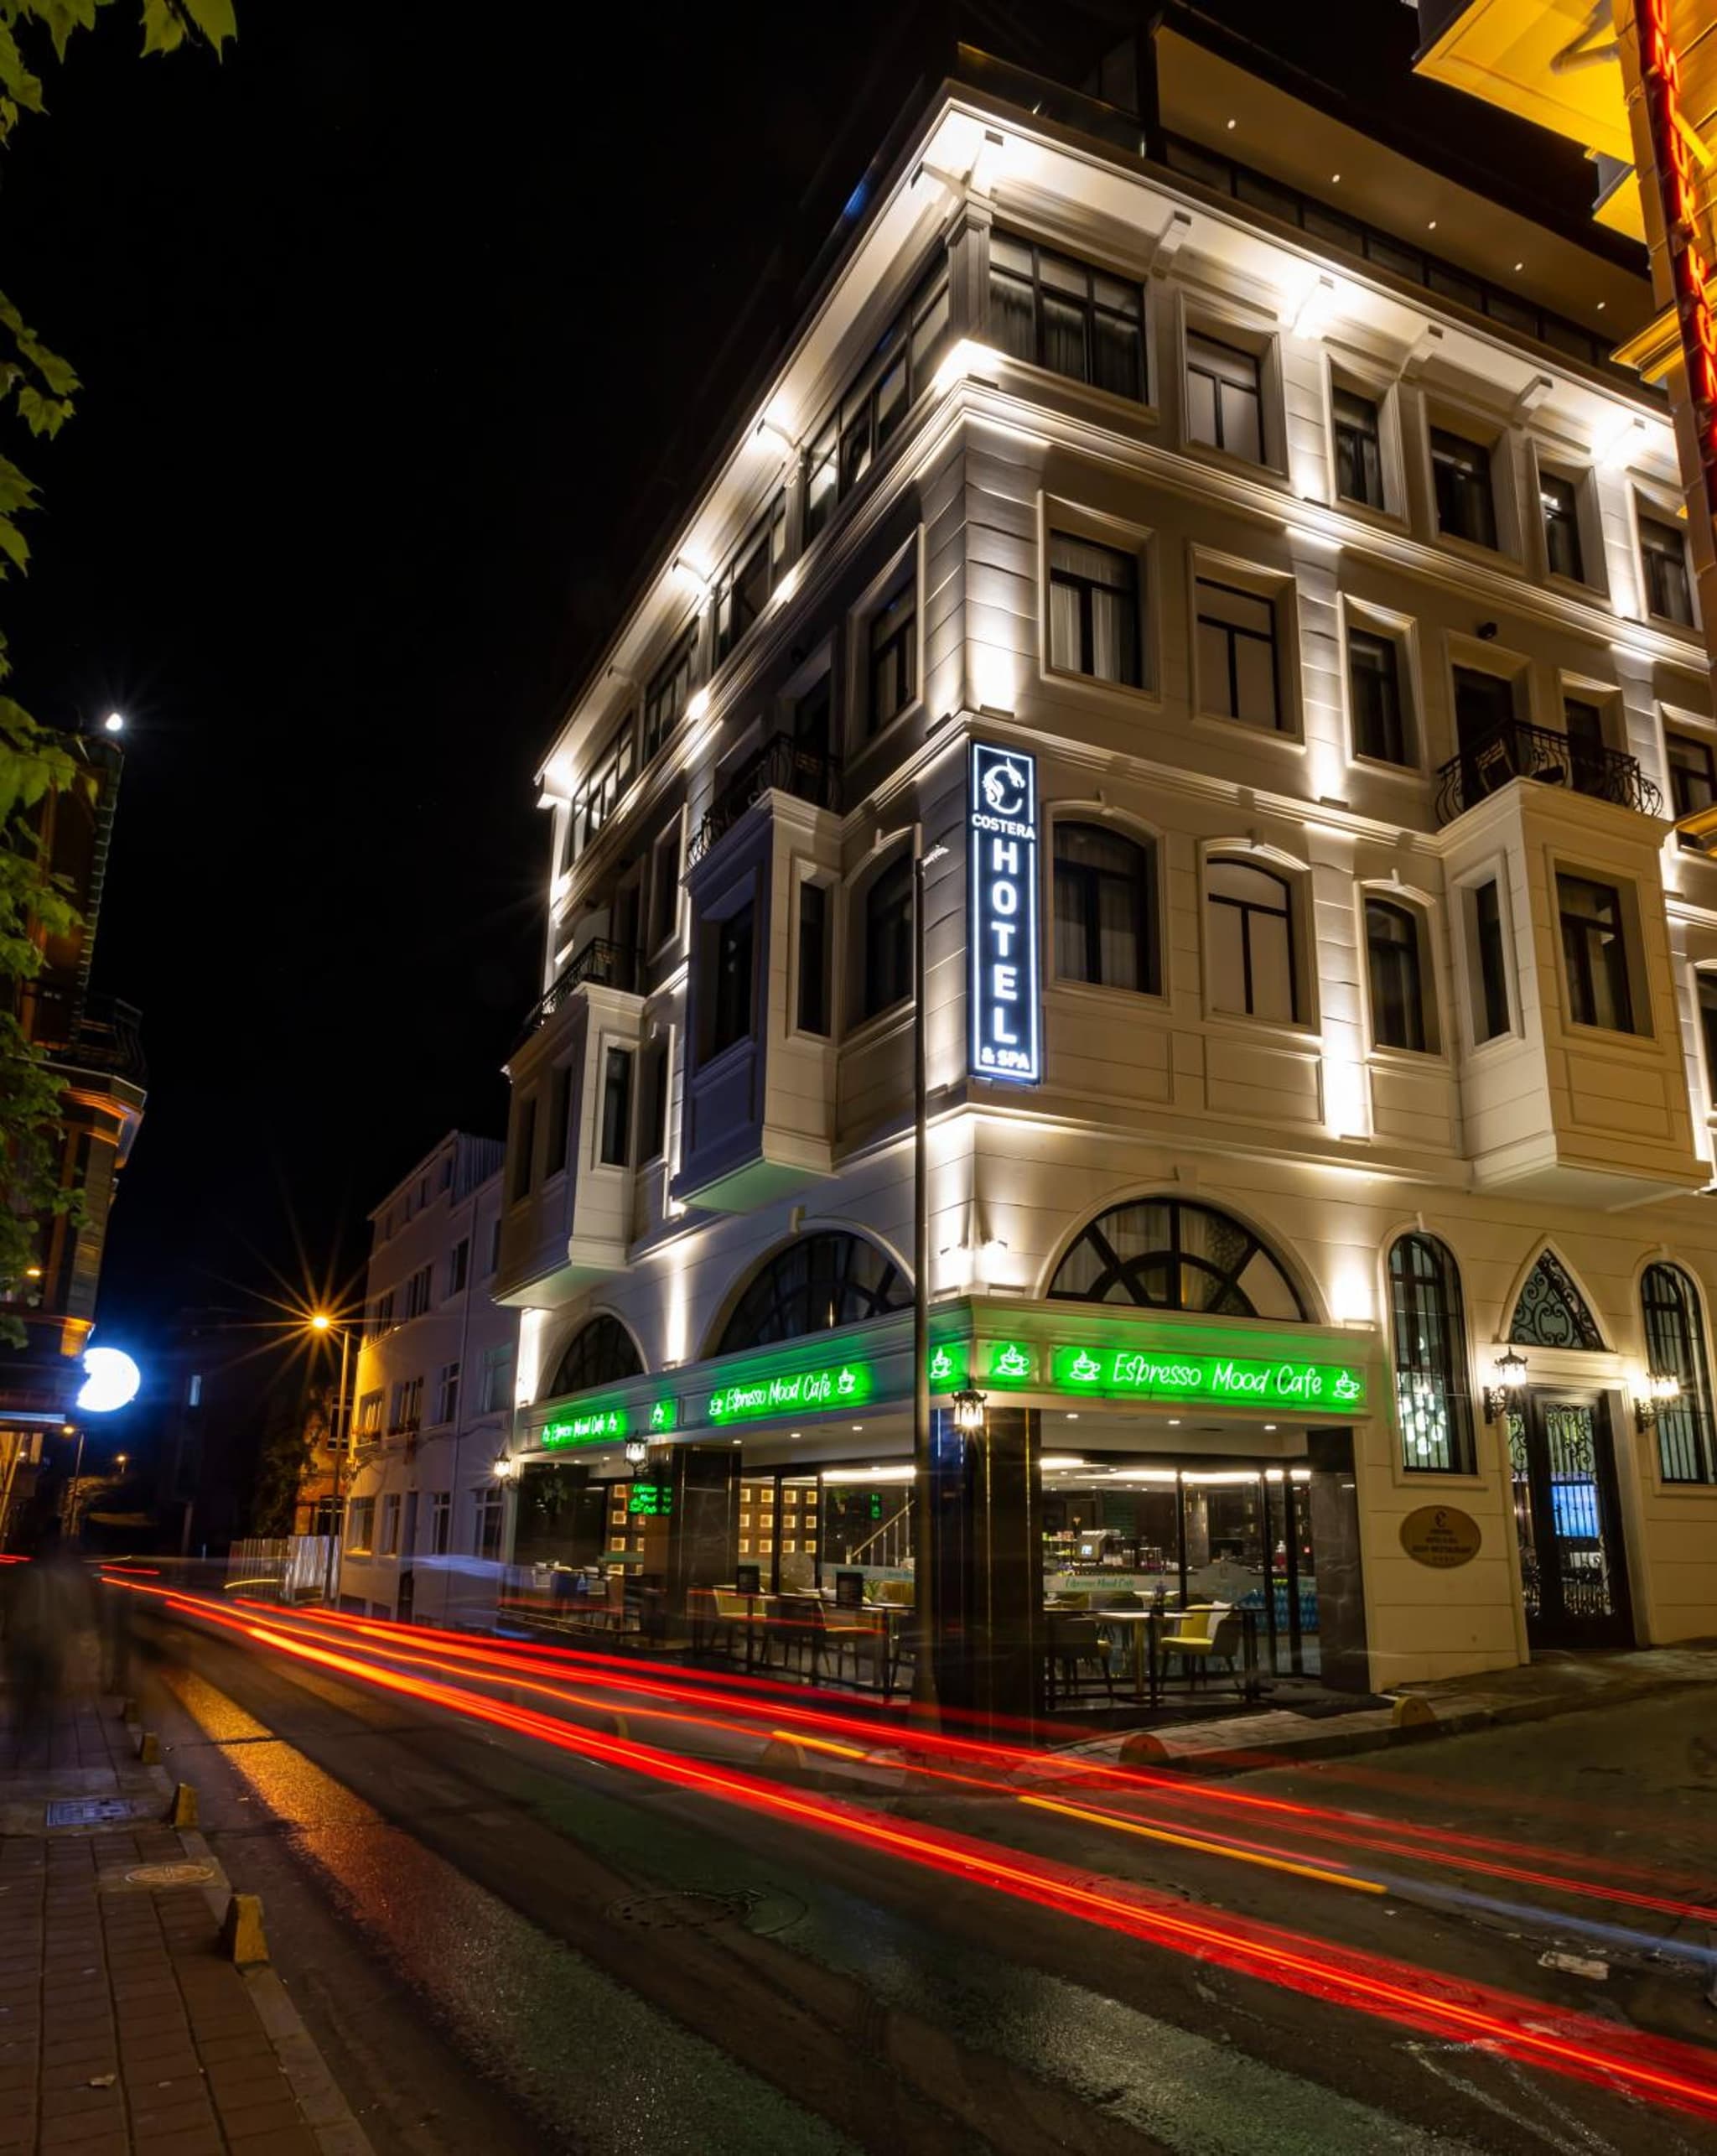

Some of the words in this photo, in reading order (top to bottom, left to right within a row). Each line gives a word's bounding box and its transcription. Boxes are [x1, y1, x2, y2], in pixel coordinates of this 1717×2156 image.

[972, 813, 1035, 840] COSTERA
[992, 838, 1018, 1045] HOTEL
[981, 1047, 995, 1065] &
[997, 1048, 1030, 1070] SPA
[725, 1389, 767, 1413] Espresso
[768, 1376, 801, 1406] Mood
[803, 1373, 832, 1402] Cafe
[1113, 1353, 1202, 1386] Espresso
[1212, 1361, 1271, 1394] Mood
[1277, 1364, 1322, 1400] Cafe
